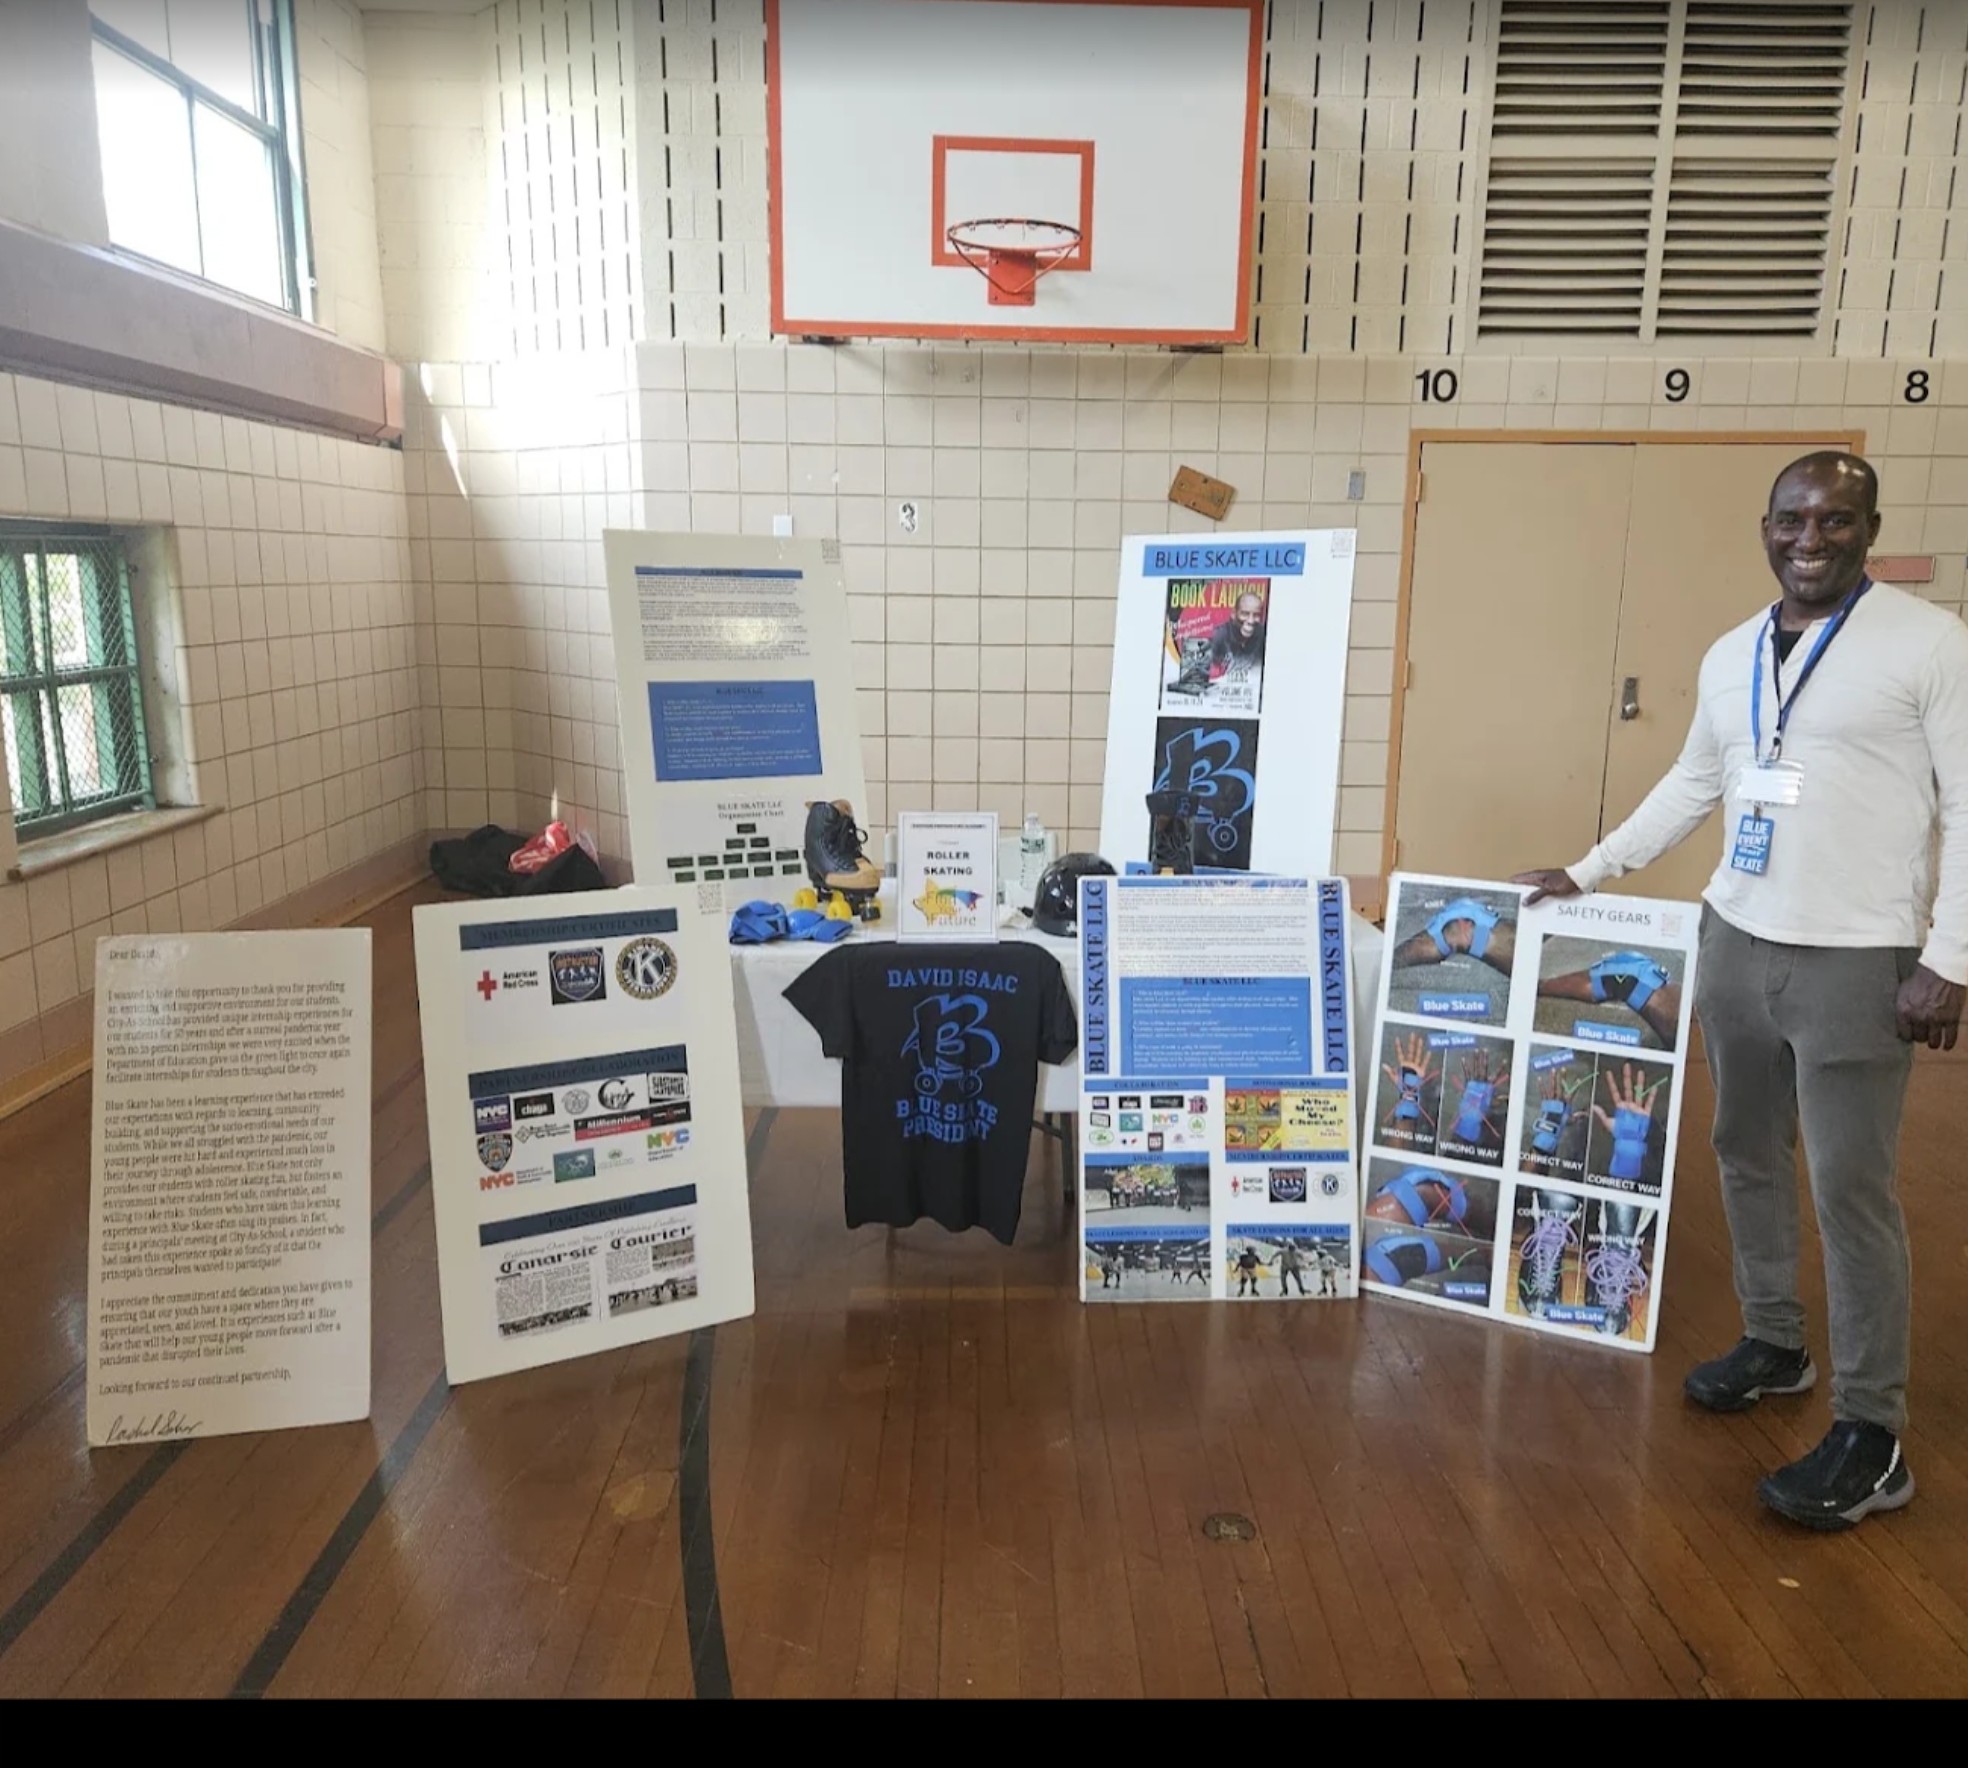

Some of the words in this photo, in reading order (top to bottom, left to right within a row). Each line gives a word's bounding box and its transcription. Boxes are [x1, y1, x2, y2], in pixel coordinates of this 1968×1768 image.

[1415, 369, 1458, 402] 10
[1664, 368, 1691, 402] 9
[1904, 369, 1930, 403] 8
[1155, 550, 1199, 568] BLUE
[1205, 549, 1258, 567] SKATE
[1265, 548, 1298, 568] LLC
[1171, 583, 1206, 608] BOOK
[1742, 820, 1770, 835] BLUE
[927, 851, 970, 860] ROLLER
[1733, 855, 1764, 872] SKATE
[923, 866, 973, 876] SKATING
[1086, 881, 1103, 927] LLC
[1322, 882, 1339, 942] BLUE
[1558, 904, 1605, 920] SAFETY
[1607, 911, 1652, 926] GEARS
[503, 970, 538, 980] American
[887, 968, 954, 987] DAVID
[957, 969, 1018, 993] ISAAC
[1087, 938, 1105, 1006] SKATE
[503, 980, 518, 989] Red
[519, 979, 538, 988] Cross
[1324, 947, 1343, 1020] SKATE
[1423, 1000, 1450, 1011] Blue
[1452, 1001, 1485, 1011] Skate
[1087, 1016, 1105, 1073] BLUE
[1430, 1037, 1450, 1046] Blue
[1451, 1036, 1475, 1045] Skate
[1577, 1026, 1603, 1040] Blue
[1605, 1031, 1638, 1045] Skate
[1327, 1027, 1345, 1072] LLC
[1533, 1059, 1551, 1069] Blue
[1552, 1052, 1574, 1064] Skate
[476, 1103, 508, 1119] NYC
[895, 1096, 941, 1119] BUE
[1307, 1111, 1324, 1119] My
[1153, 1114, 1179, 1124] NYC
[647, 1128, 690, 1149] NYC
[903, 1115, 991, 1143] PRESIDNT
[1381, 1127, 1413, 1140] WRONG
[1415, 1133, 1435, 1144] WAY
[1439, 1141, 1475, 1155] WRONG
[1476, 1147, 1499, 1159] WAY
[1519, 1152, 1560, 1167] CORRECT
[1562, 1160, 1584, 1171] WAY
[480, 1172, 515, 1190] NYC
[1587, 1173, 1635, 1190] CORRECT
[1637, 1183, 1662, 1195] WAY
[499, 1244, 600, 1275] Canarsie
[610, 1224, 693, 1250] Courier
[1550, 1307, 1573, 1318] Blue
[1574, 1309, 1604, 1322] Skate
